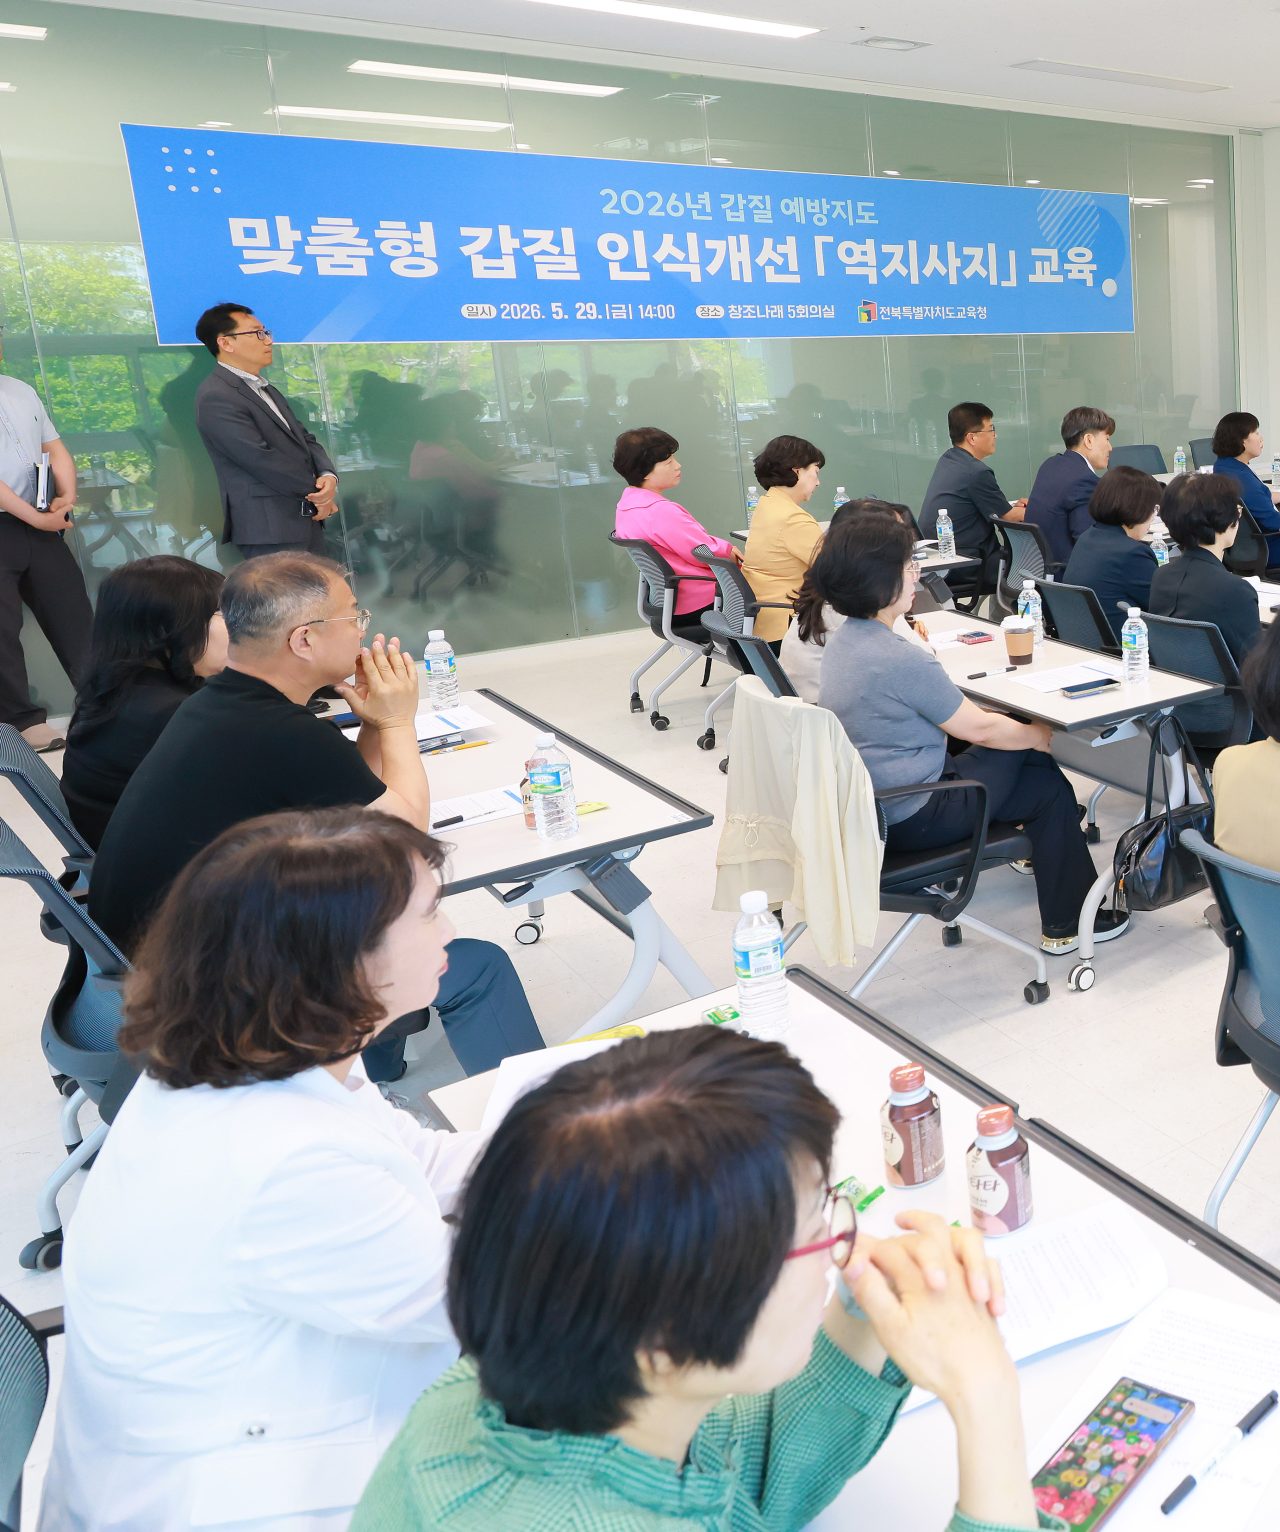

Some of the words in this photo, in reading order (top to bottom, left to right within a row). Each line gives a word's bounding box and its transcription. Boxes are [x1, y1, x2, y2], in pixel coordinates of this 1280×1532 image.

[599, 187, 713, 221] 2026년
[720, 193, 774, 224] 갑질
[780, 196, 879, 226] 예방지도
[228, 215, 439, 278] 맞춤형
[458, 224, 581, 281] 갑질
[597, 230, 801, 283] 인식개선
[1028, 246, 1098, 287] 교육
[465, 305, 492, 318] 일시
[500, 303, 546, 320] 2026.
[551, 302, 569, 320] 5.
[638, 304, 676, 320] 14:00
[699, 306, 721, 318] 장소
[728, 305, 784, 319] 창조나래
[787, 304, 835, 319] 5회의실
[879, 305, 988, 320] 전북특별자치도교육청
